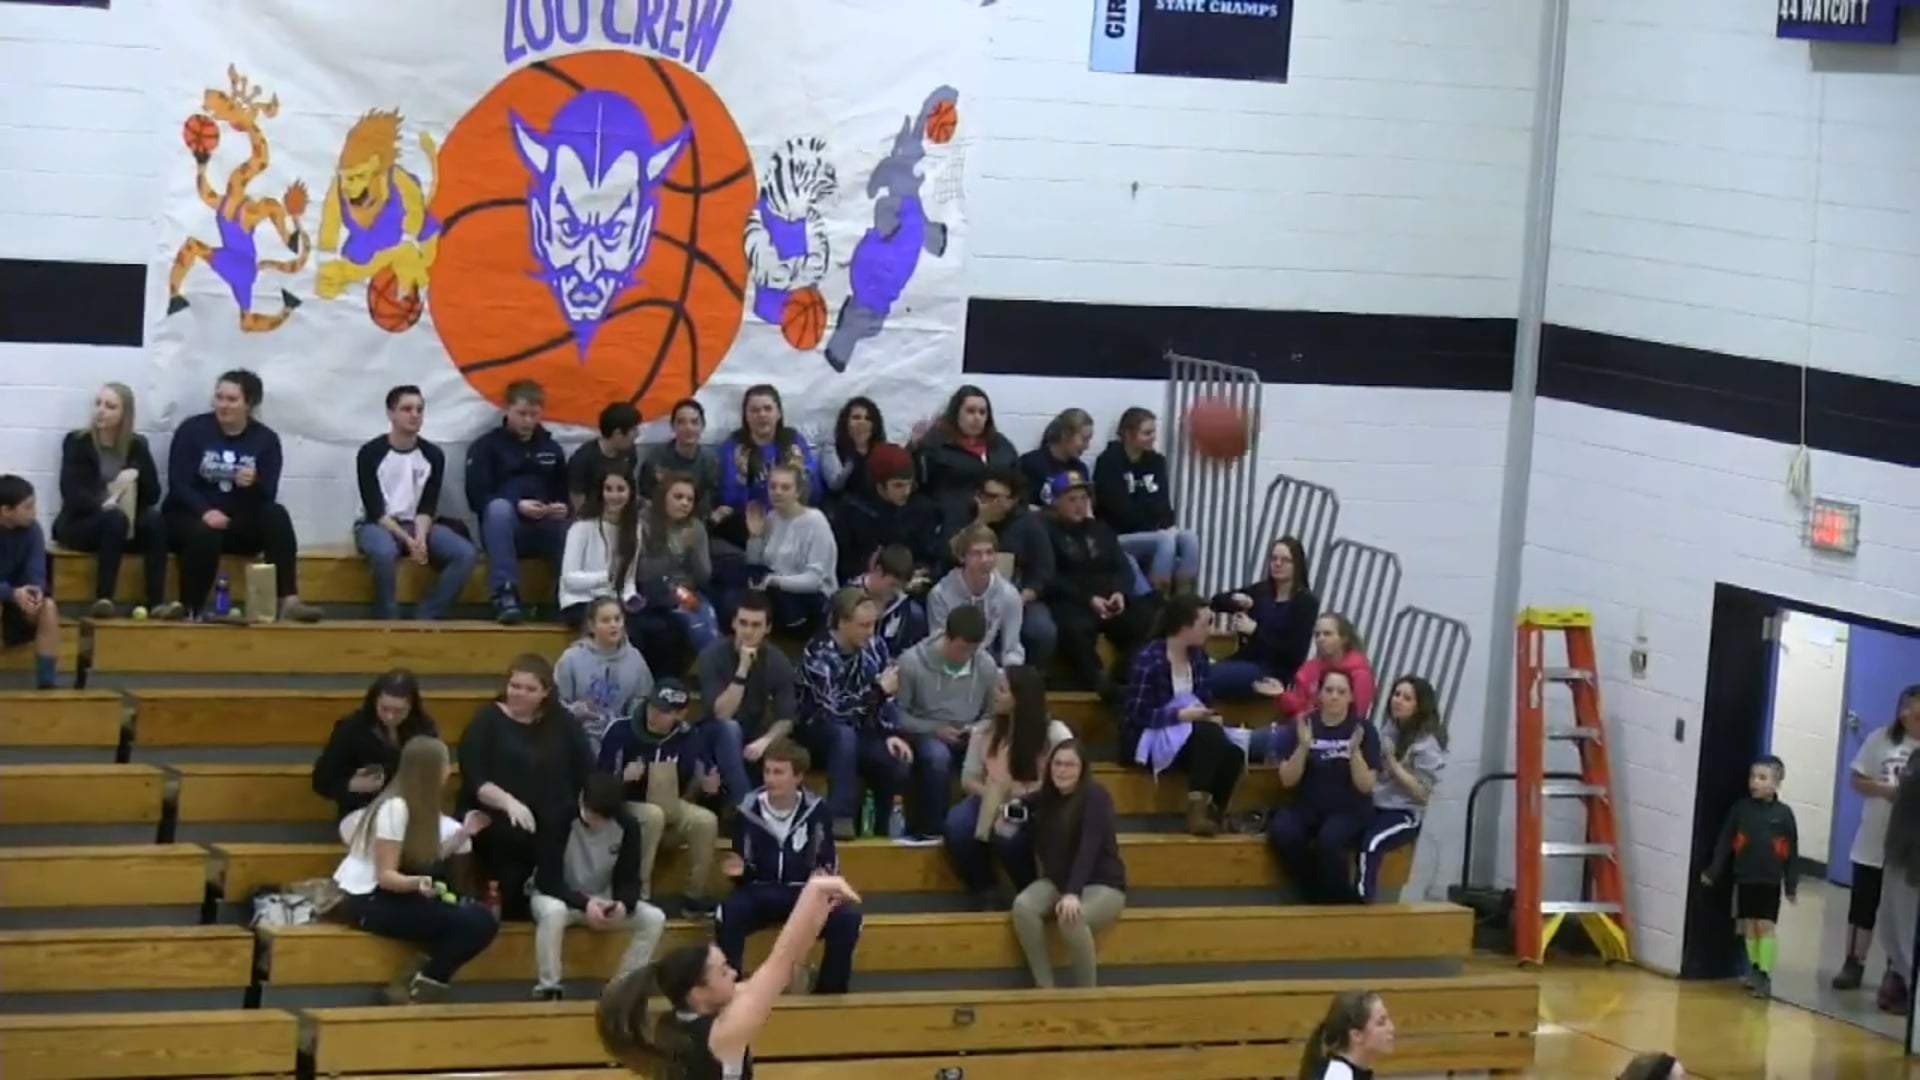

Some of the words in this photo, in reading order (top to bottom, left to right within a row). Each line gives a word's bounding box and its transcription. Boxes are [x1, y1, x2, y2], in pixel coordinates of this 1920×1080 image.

[1155, 0, 1205, 13] STATE
[1209, 0, 1279, 17] CHAMPS
[601, 0, 734, 72] CREW
